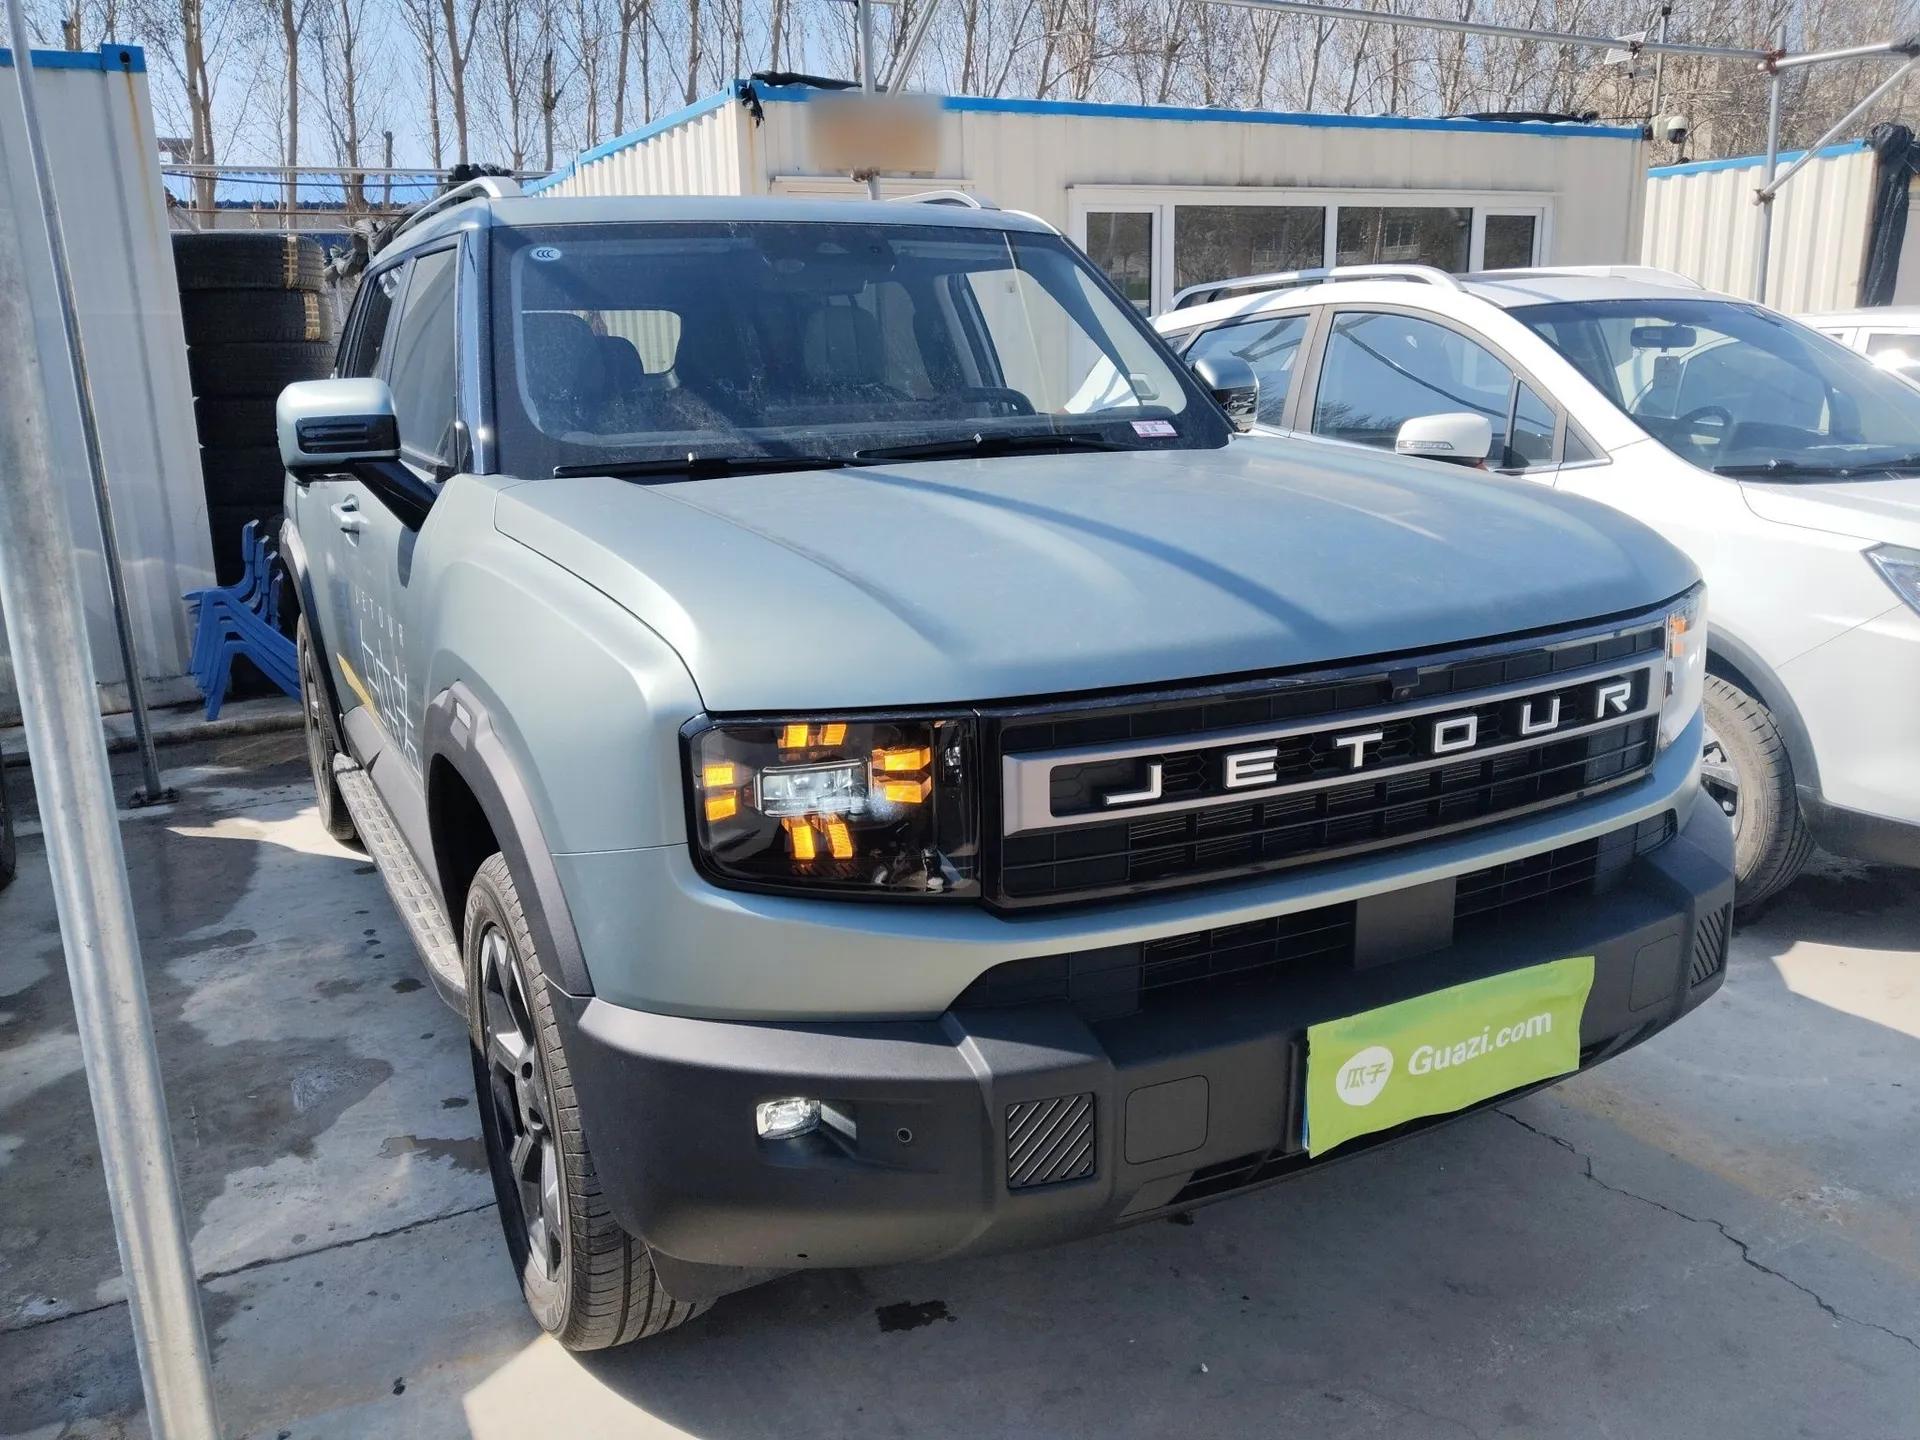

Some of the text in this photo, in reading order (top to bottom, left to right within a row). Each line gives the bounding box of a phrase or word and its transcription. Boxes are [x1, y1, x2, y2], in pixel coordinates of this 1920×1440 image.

[354, 586, 404, 649] JETOUR
[1104, 682, 1632, 806] JETOUR
[1344, 1011, 1553, 1091] 瓜子 Guazi.com
